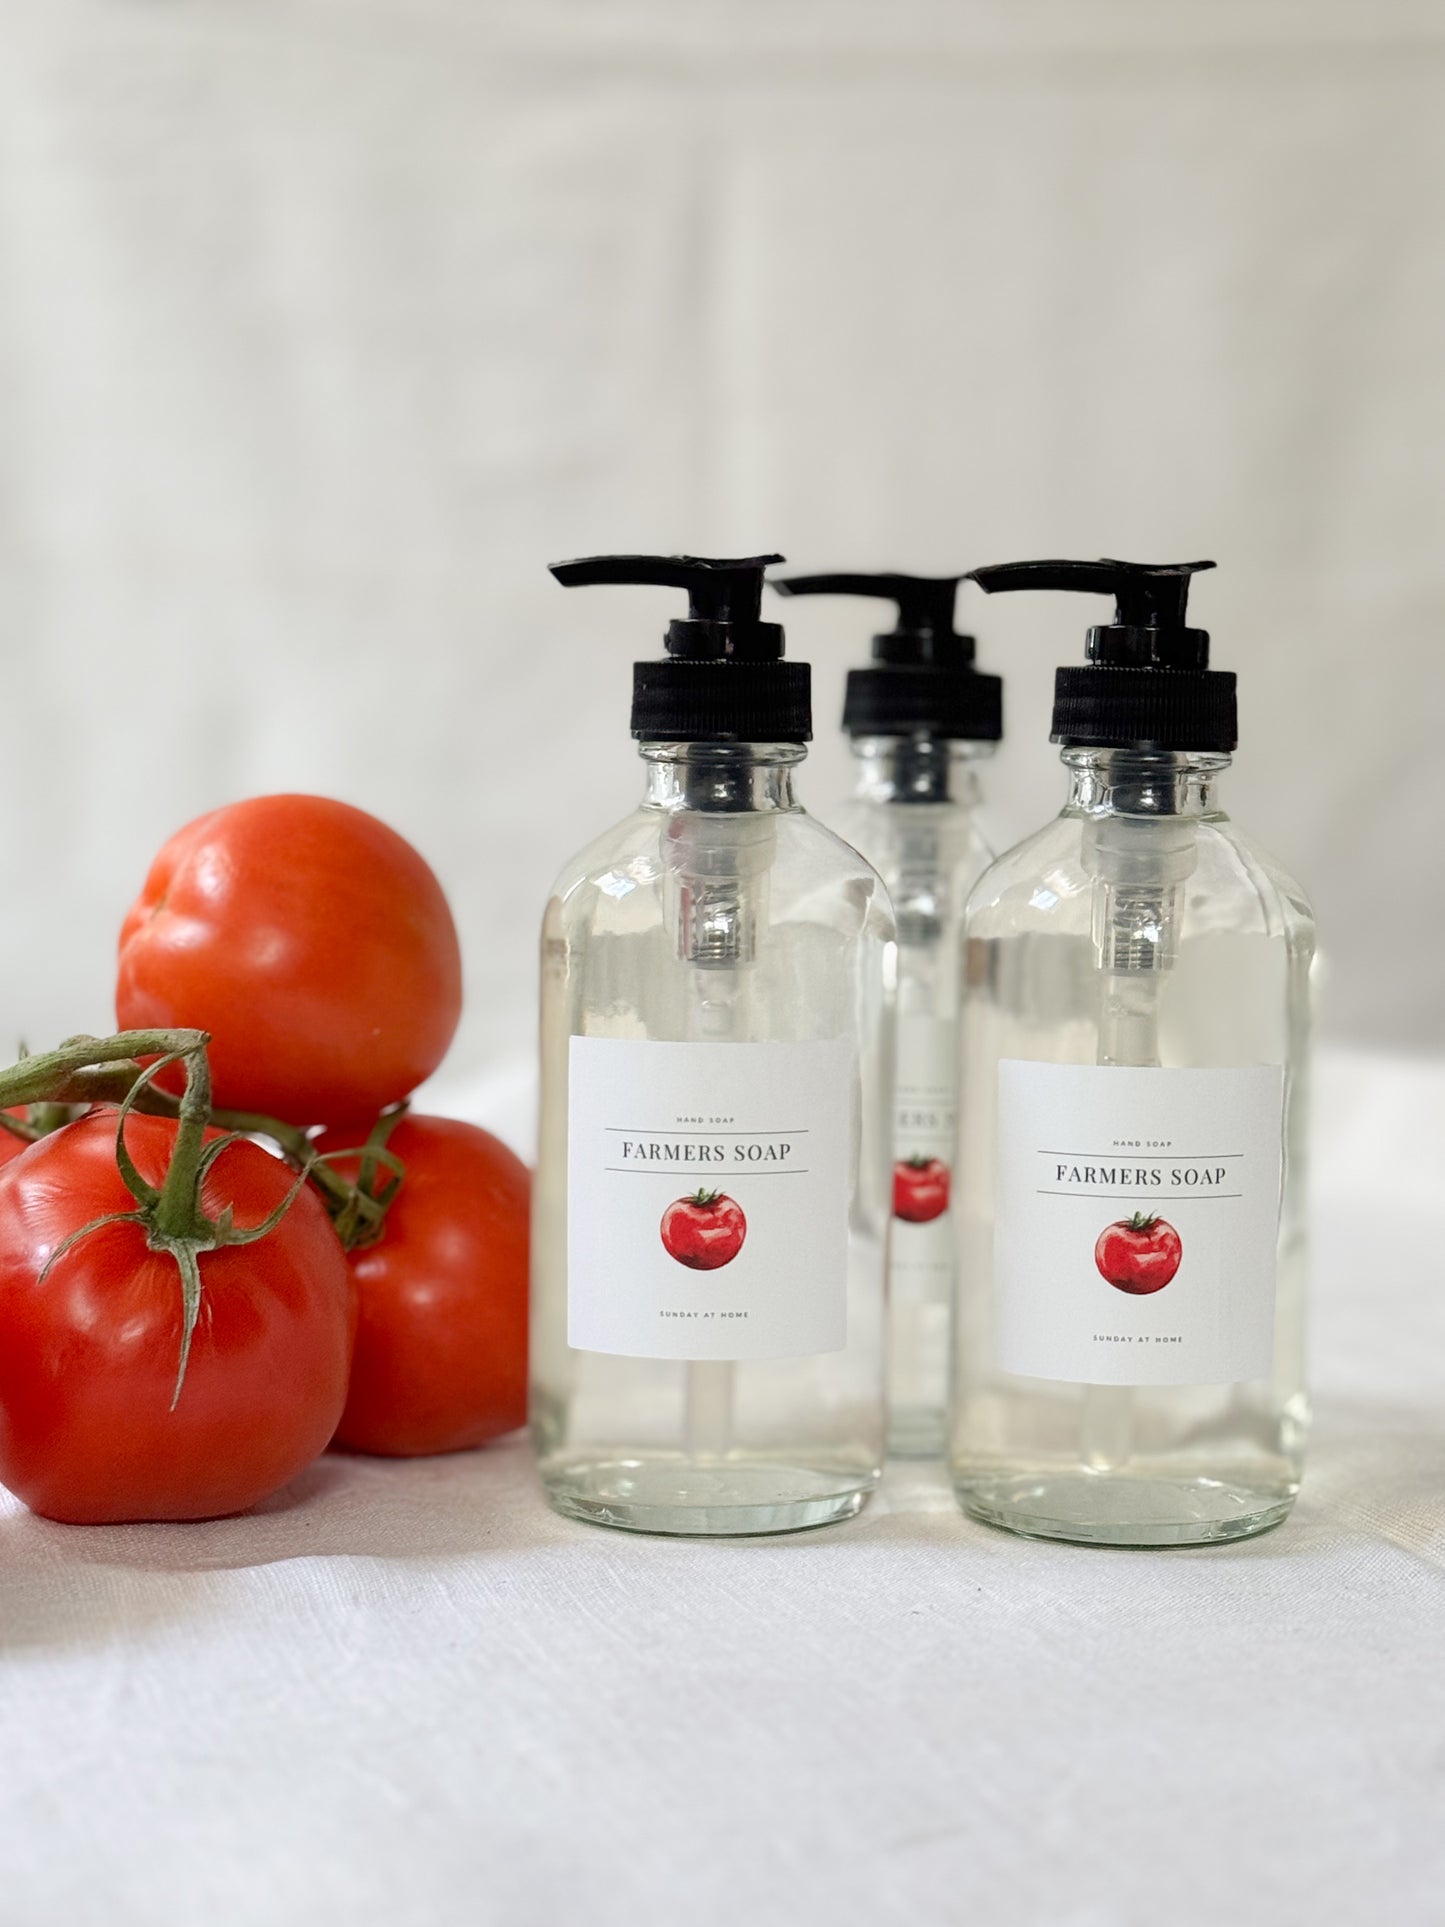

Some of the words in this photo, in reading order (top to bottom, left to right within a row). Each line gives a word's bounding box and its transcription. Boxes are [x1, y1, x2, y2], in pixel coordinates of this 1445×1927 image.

[677, 1116, 704, 1124] HAND
[709, 1116, 735, 1124] SOAP
[1113, 1140, 1141, 1148] HAND
[1146, 1140, 1172, 1148] SOAP
[622, 1141, 725, 1161] FARMERS
[734, 1143, 791, 1161] SOAP
[1056, 1164, 1161, 1185] FARMERS
[1171, 1167, 1226, 1185] SOAP
[659, 1310, 699, 1319] SUNDAY
[703, 1311, 716, 1319] AT
[720, 1311, 749, 1319] HOME
[1093, 1334, 1134, 1343] SUNDAY
[1138, 1335, 1151, 1343] AT
[1155, 1335, 1183, 1343] HOME
